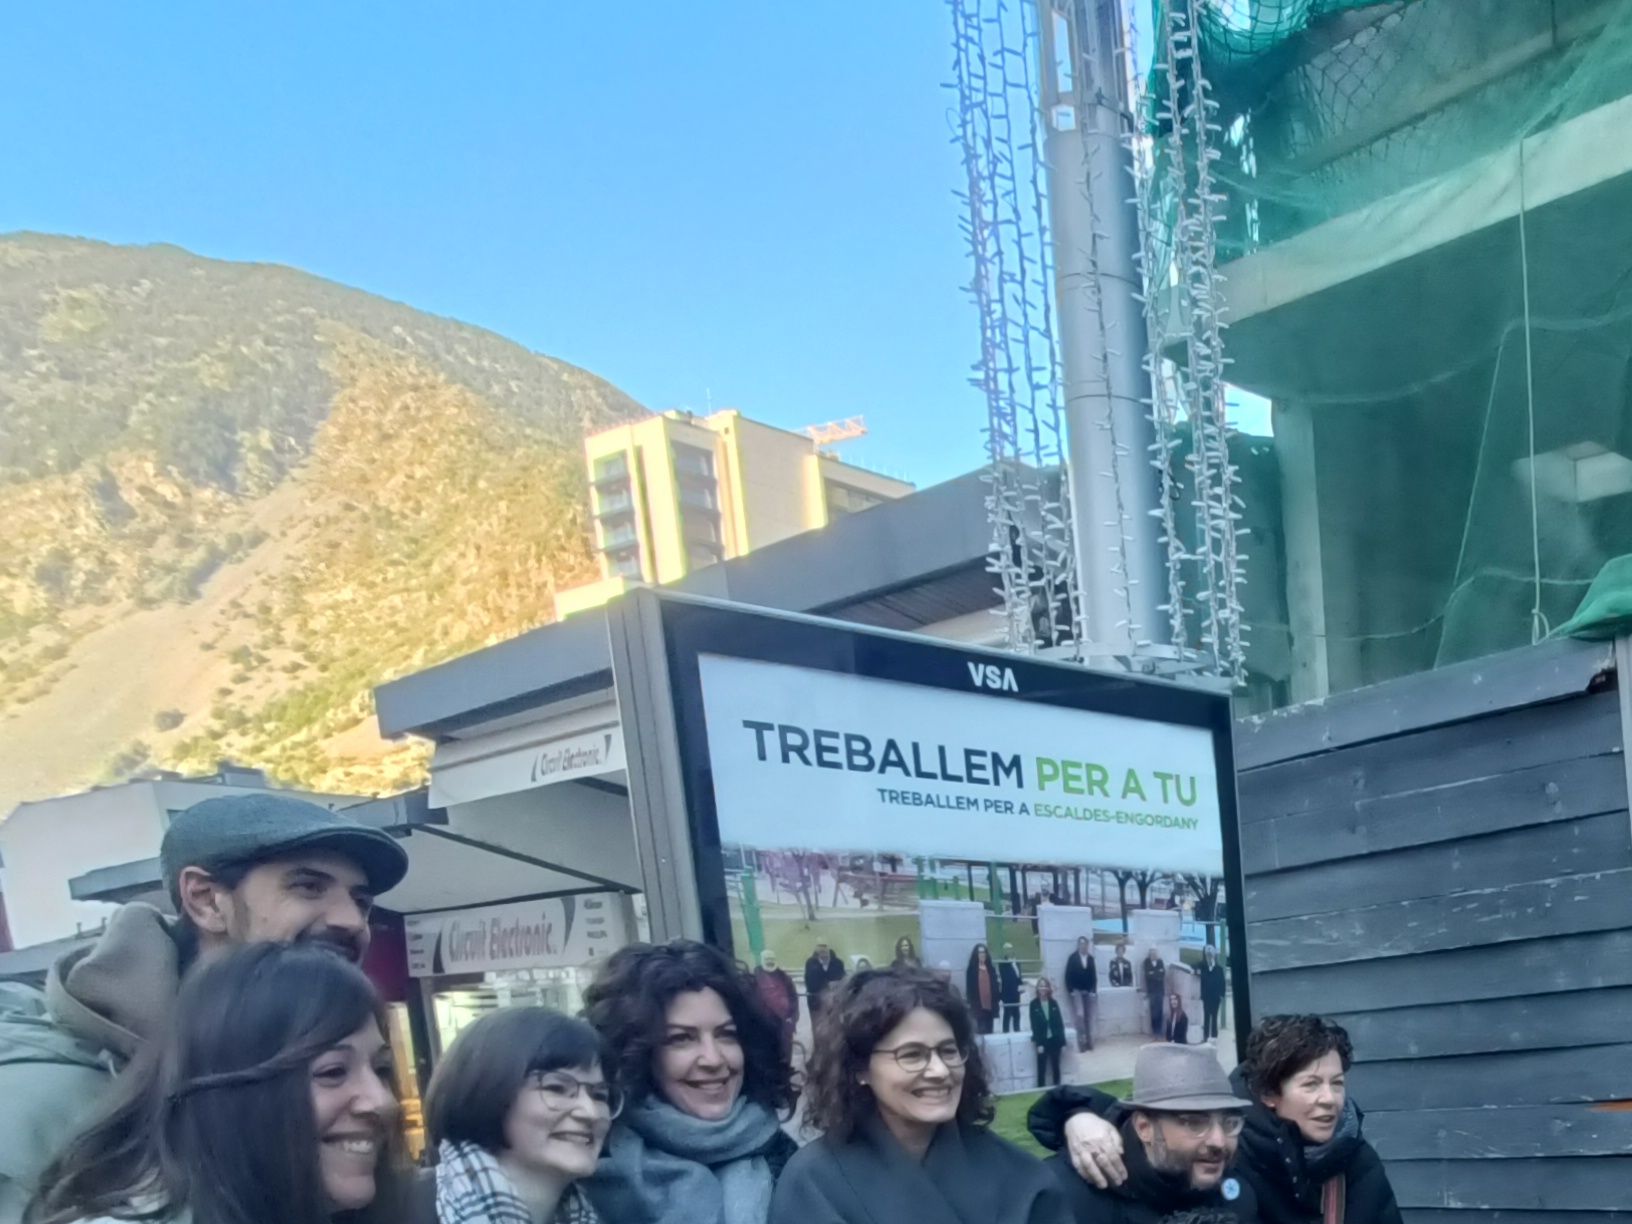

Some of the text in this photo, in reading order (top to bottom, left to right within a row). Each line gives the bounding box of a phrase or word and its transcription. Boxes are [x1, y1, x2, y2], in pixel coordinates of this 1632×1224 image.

[967, 661, 1019, 692] VSA
[742, 719, 1198, 807] TREBALLEM PER A TU
[877, 787, 1199, 830] TREBALLEM PER A ESCALDES-ENGORDANY
[450, 919, 487, 963] Circuit
